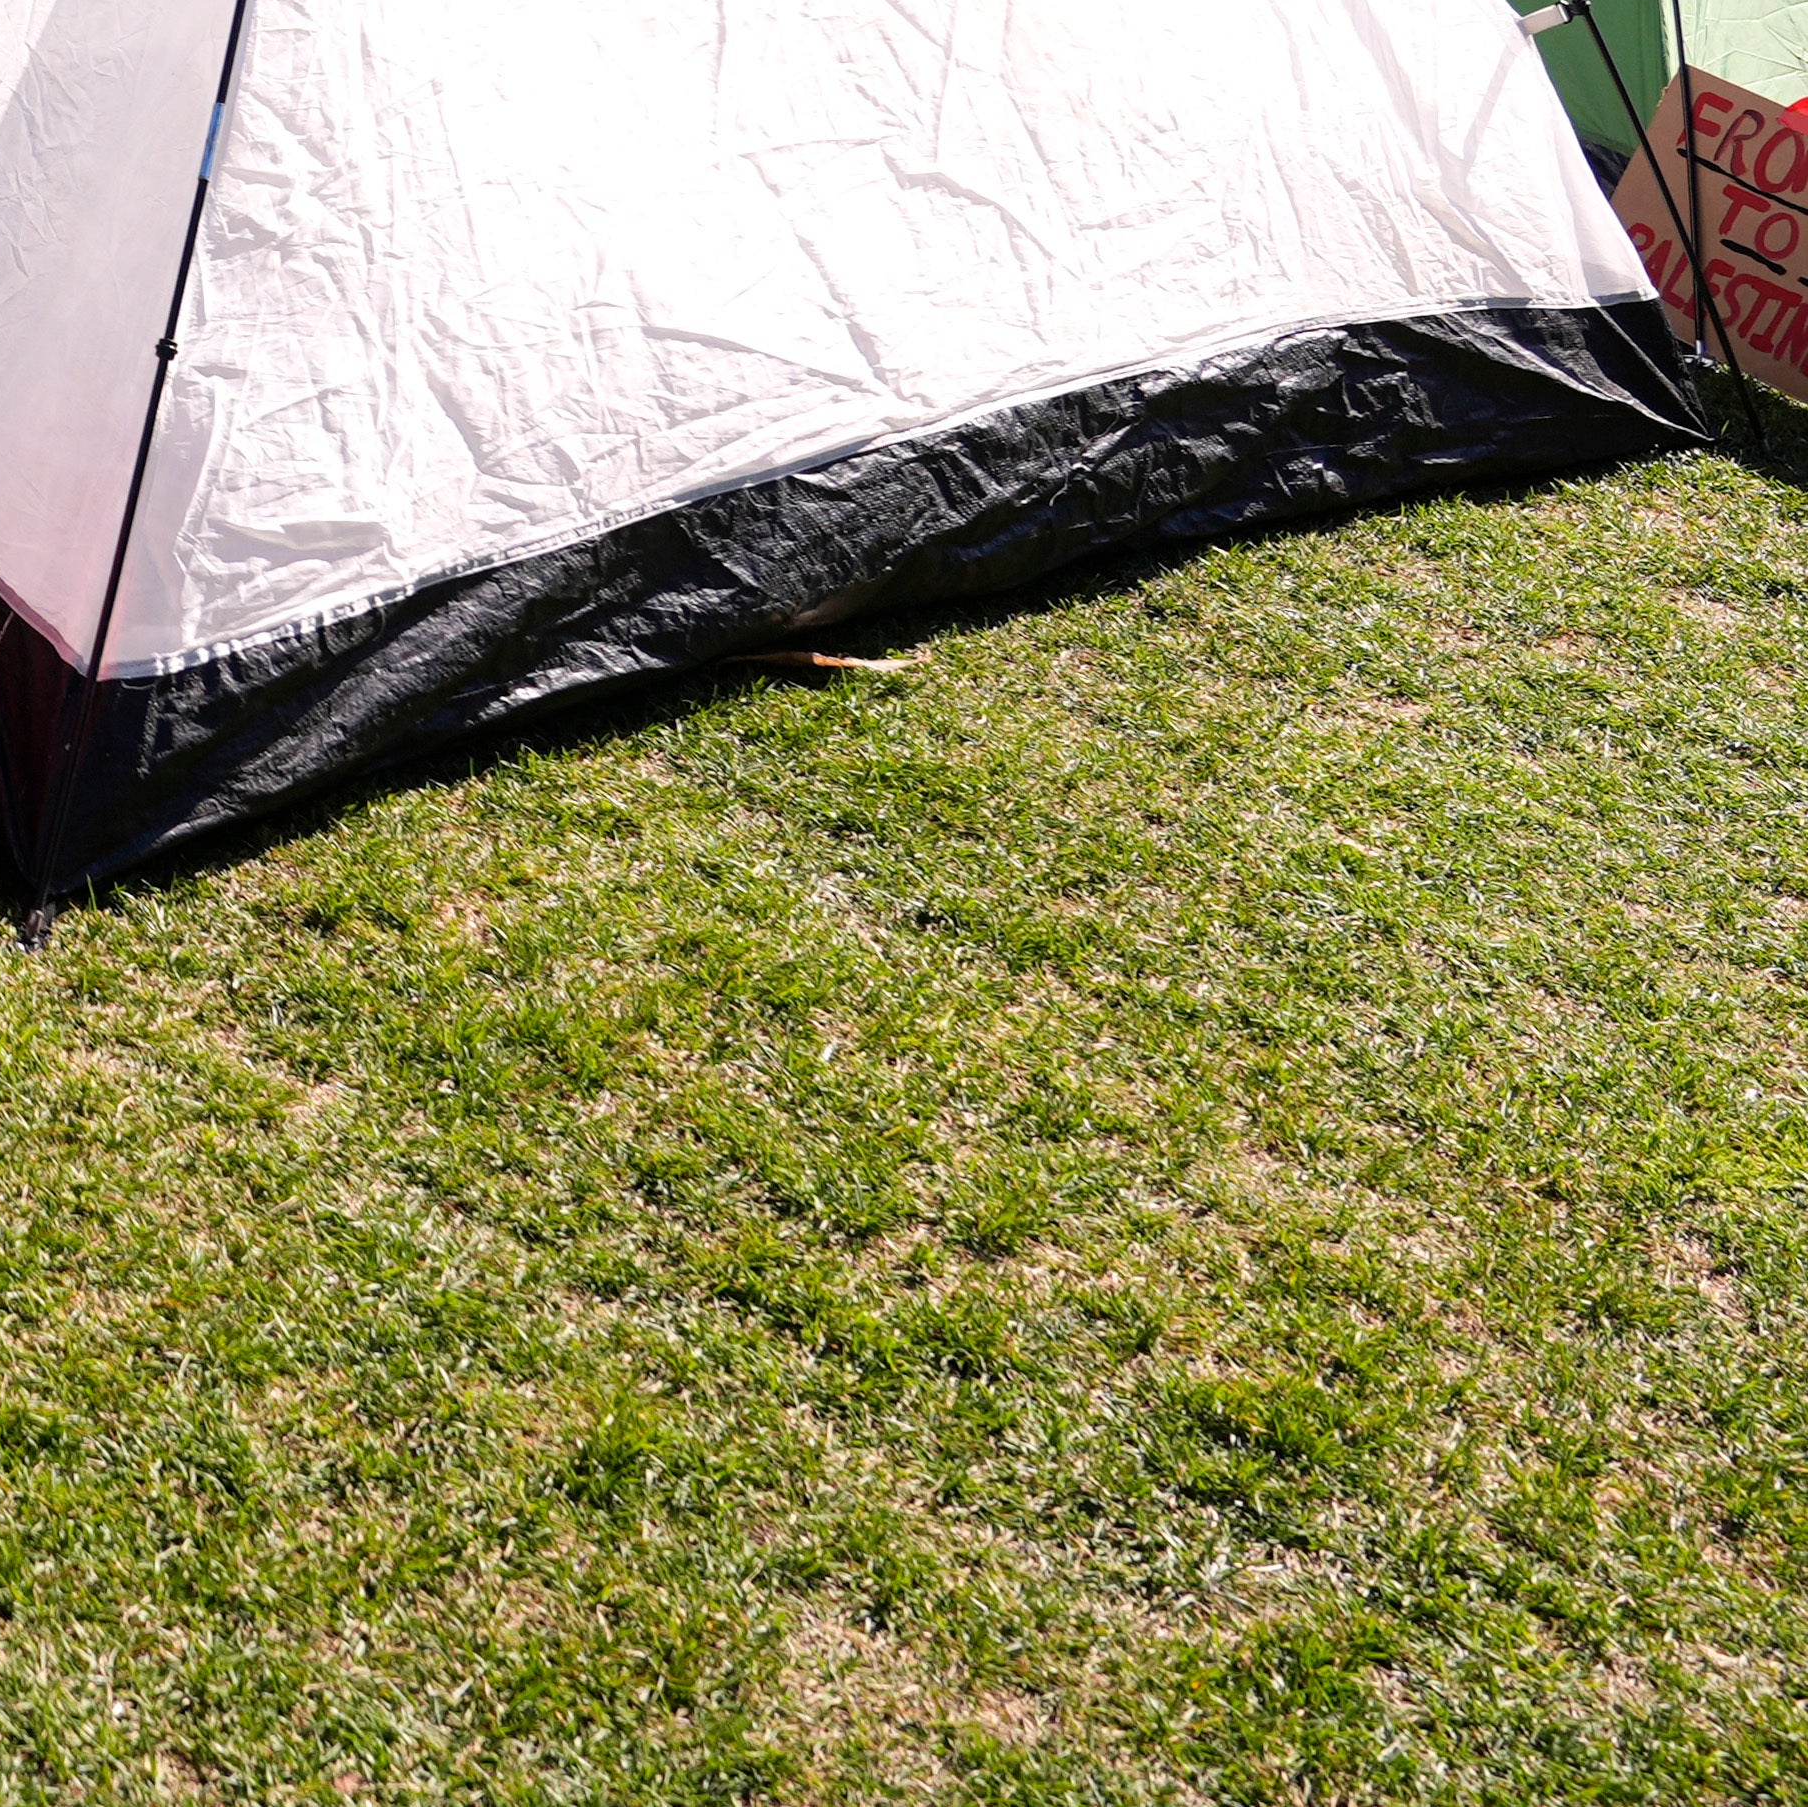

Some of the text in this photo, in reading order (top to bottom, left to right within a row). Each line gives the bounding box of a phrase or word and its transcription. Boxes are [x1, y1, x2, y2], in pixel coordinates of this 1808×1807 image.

[1676, 91, 1808, 195] FRO
[1719, 183, 1800, 261] TO
[1627, 222, 1808, 379] PALESTIN
